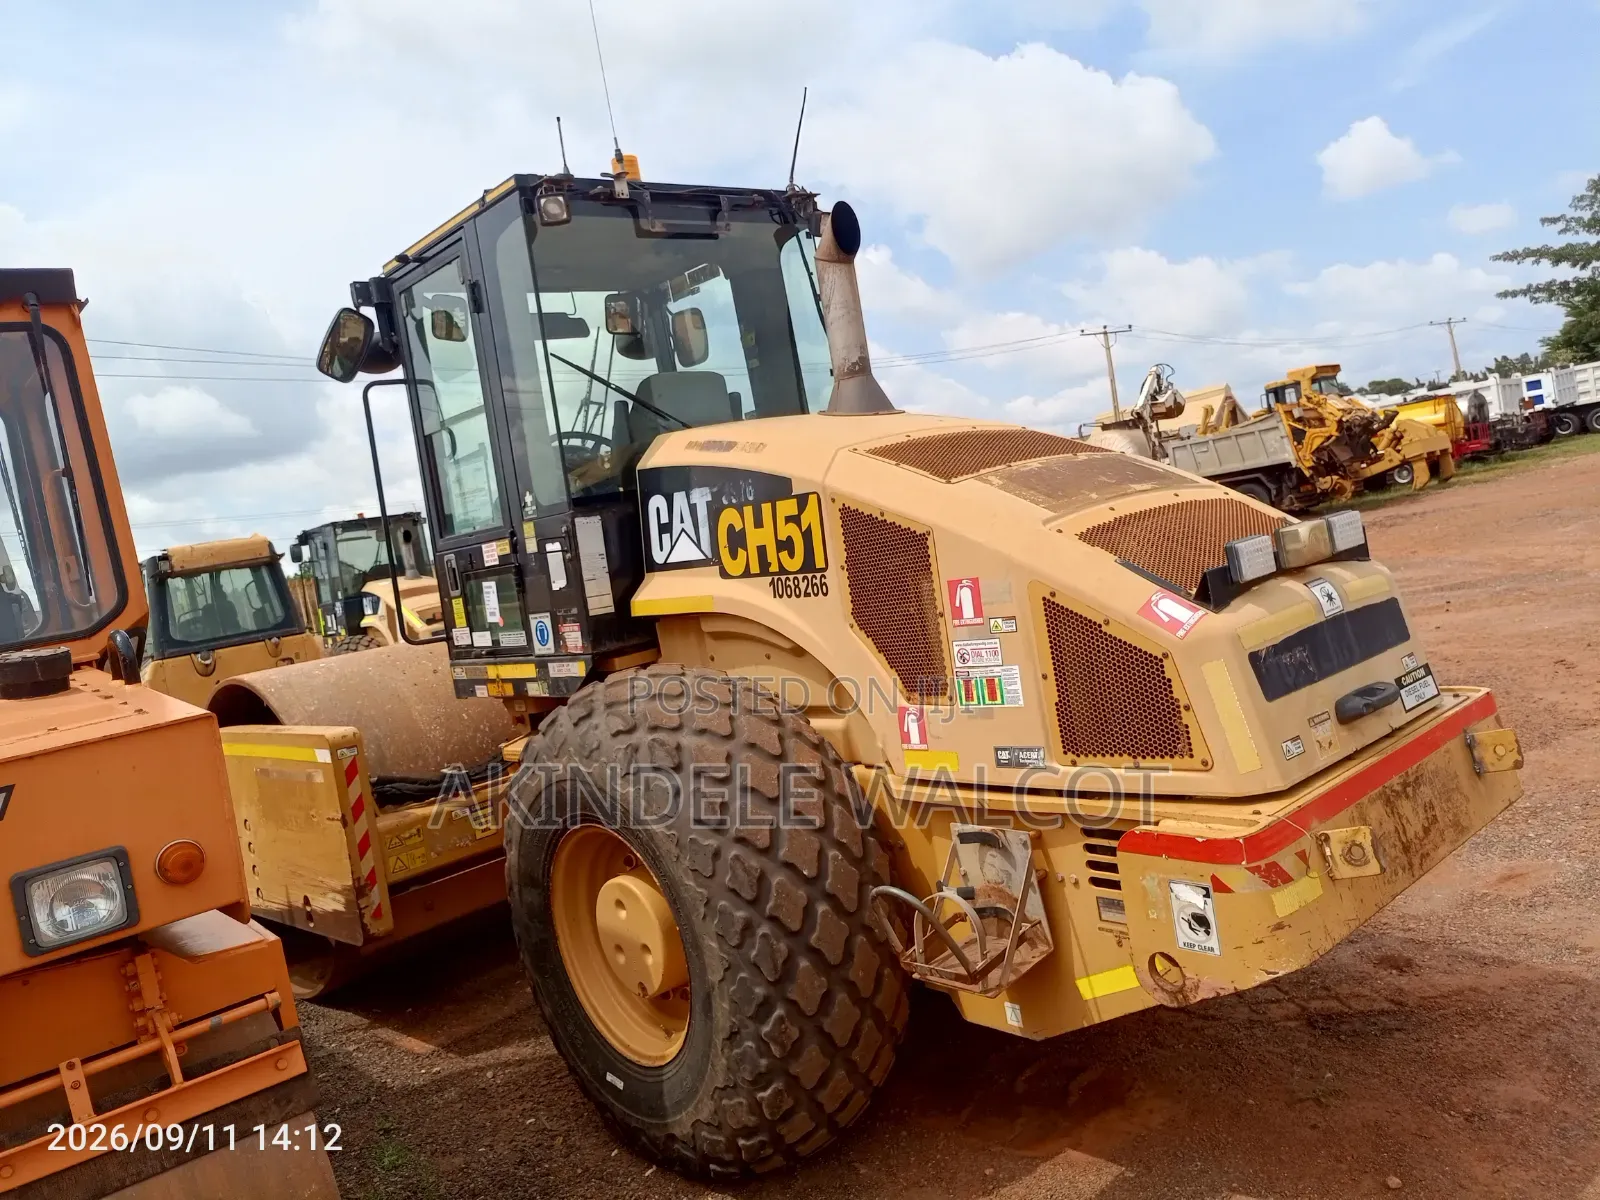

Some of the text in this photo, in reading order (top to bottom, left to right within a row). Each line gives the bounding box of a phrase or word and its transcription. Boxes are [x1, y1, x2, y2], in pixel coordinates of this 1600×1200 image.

[647, 486, 713, 565] CAT
[717, 493, 826, 577] CH51
[769, 573, 829, 599] 1068266
[1401, 667, 1426, 686] CAUTION
[1404, 680, 1431, 698] DIESEL FUEL
[1414, 691, 1426, 703] ONLY
[997, 750, 1010, 760] CAT
[1182, 941, 1215, 953] KEEP CLEAR
